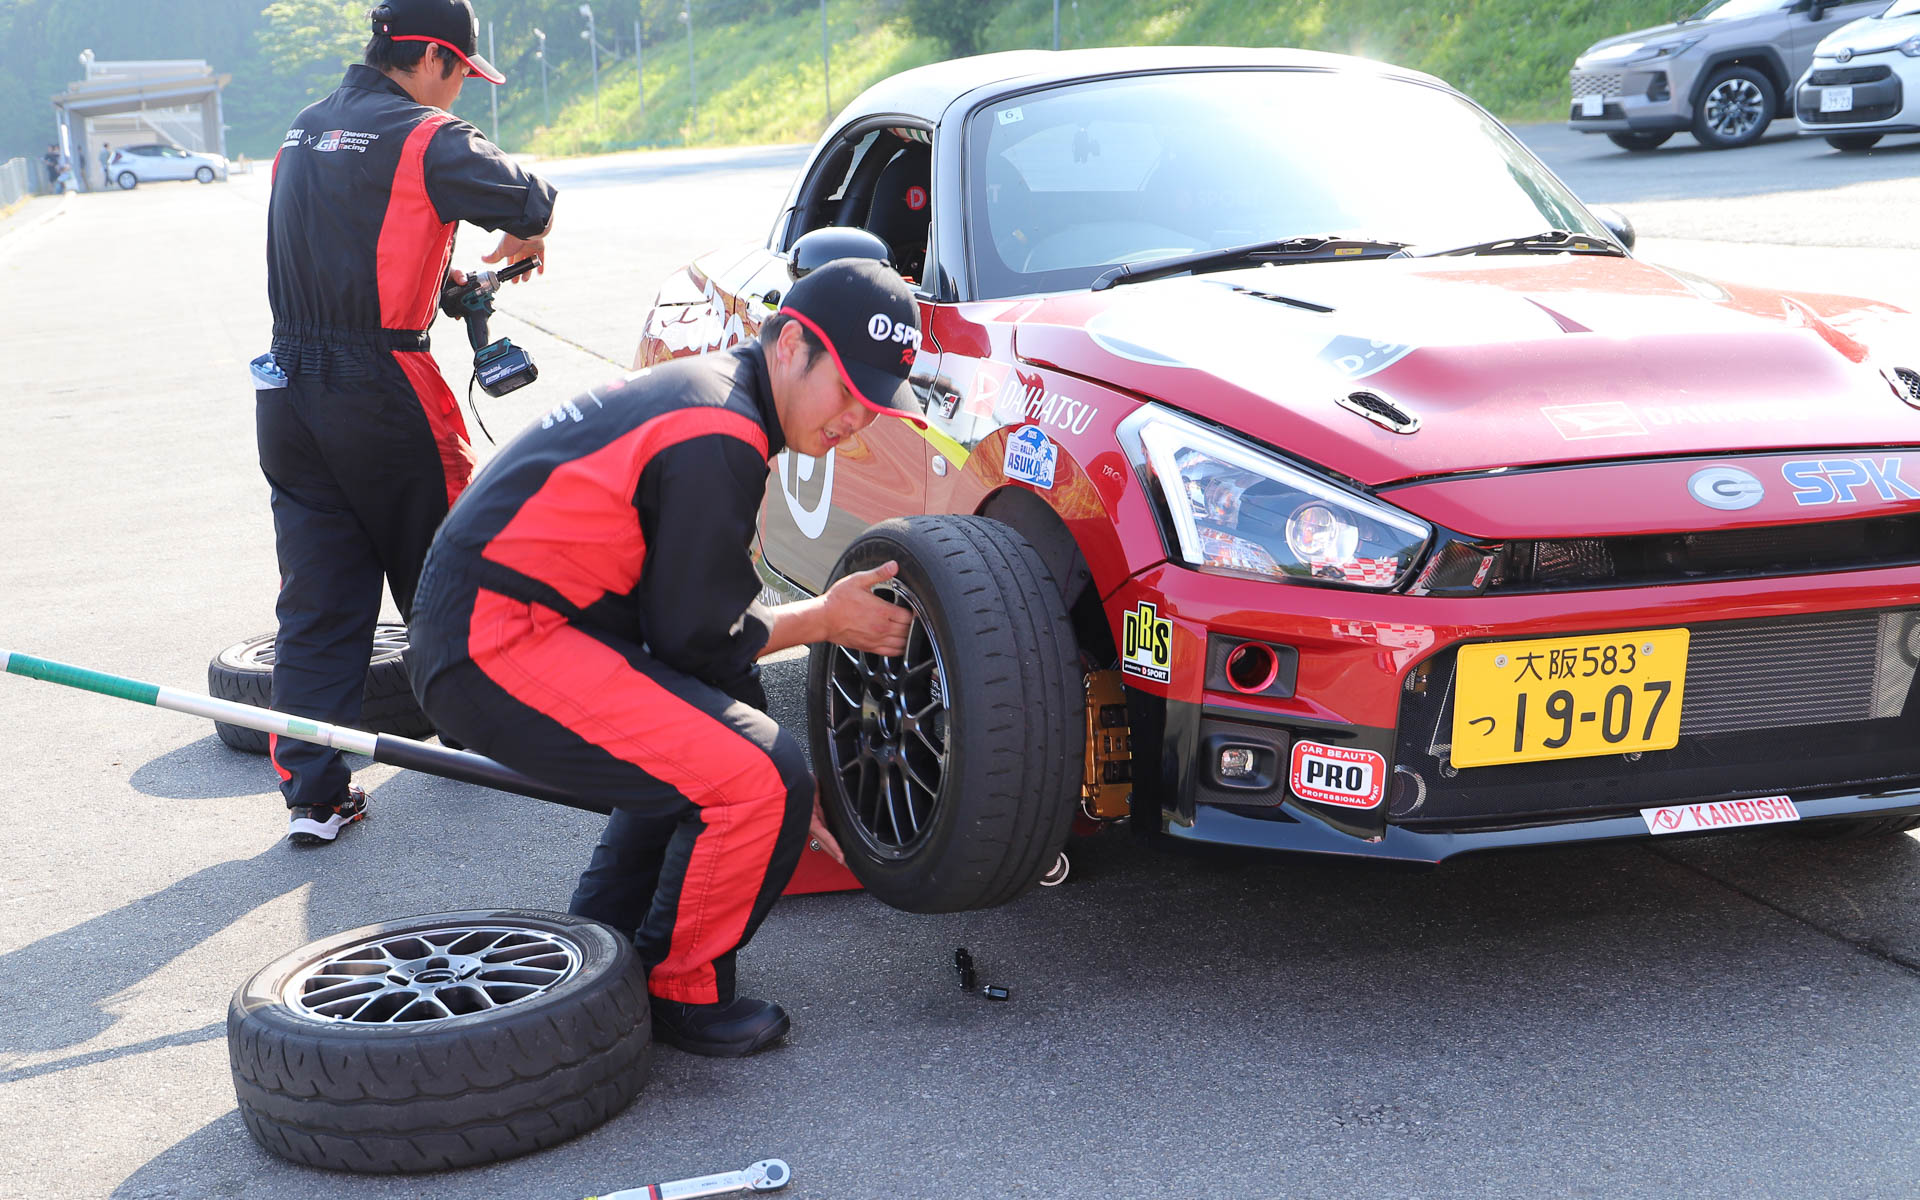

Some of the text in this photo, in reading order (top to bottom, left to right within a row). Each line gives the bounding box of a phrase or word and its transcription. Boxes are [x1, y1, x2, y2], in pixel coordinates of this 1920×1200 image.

[338, 143, 367, 153] Racing
[340, 137, 370, 145] GAZOO
[342, 131, 380, 140] DAIHATSU
[891, 322, 922, 350] SPO
[1002, 381, 1098, 435] DAIHATSU
[1020, 444, 1034, 456] RALLY
[1007, 452, 1041, 477] ASUKA
[1782, 458, 1920, 506] SPK
[1126, 605, 1169, 665] DRS
[1147, 668, 1167, 680] SPORT
[1468, 680, 1672, 753] つ 19-07
[1300, 744, 1376, 763] CAR BEAUTY
[1306, 760, 1363, 791] PRO
[1302, 788, 1367, 805] PROFESSIONAL
[1368, 783, 1380, 802] WAY
[1688, 797, 1797, 828] KANBISHI
